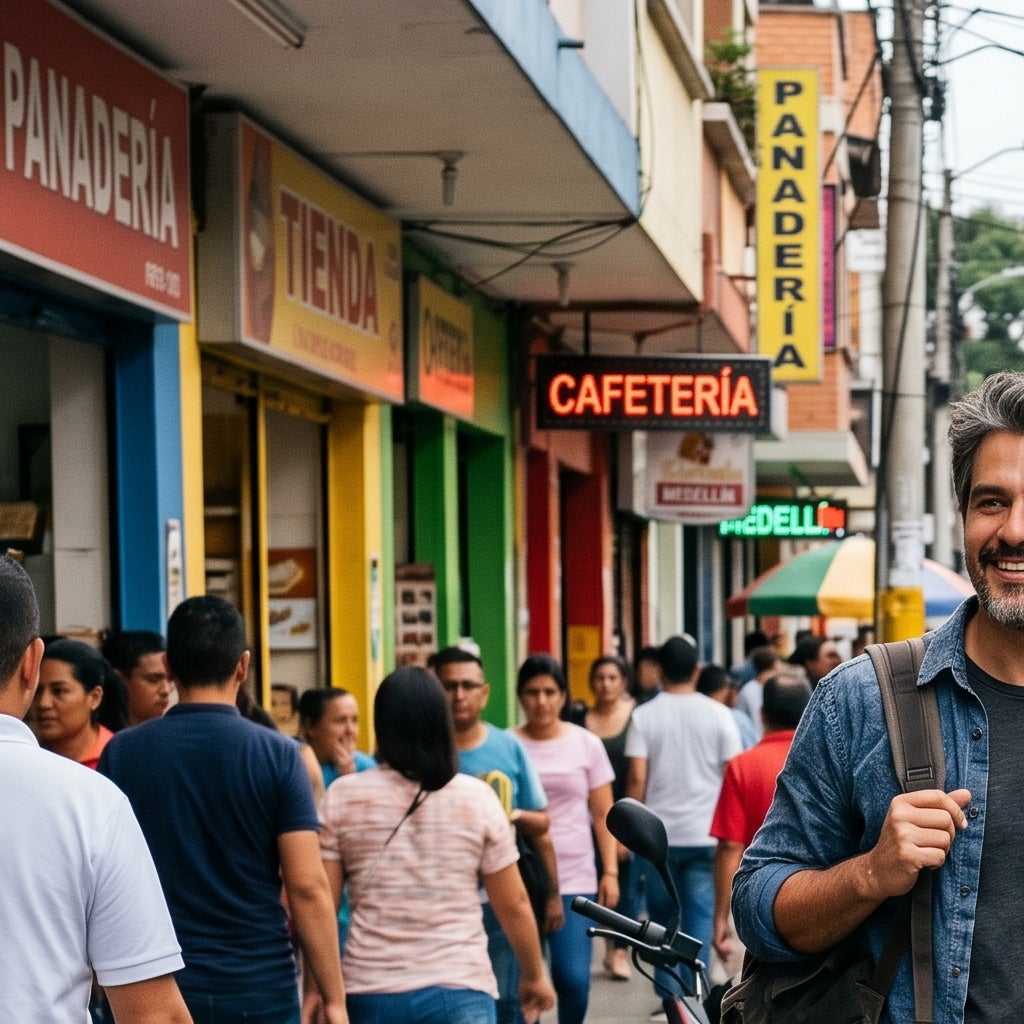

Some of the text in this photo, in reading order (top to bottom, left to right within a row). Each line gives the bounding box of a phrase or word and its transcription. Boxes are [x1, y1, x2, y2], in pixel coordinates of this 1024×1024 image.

[4, 41, 179, 250] PANADERÍA
[771, 80, 806, 368] PANADERÍA
[280, 185, 380, 340] TIENDA
[549, 365, 759, 417] CAFETERÍA
